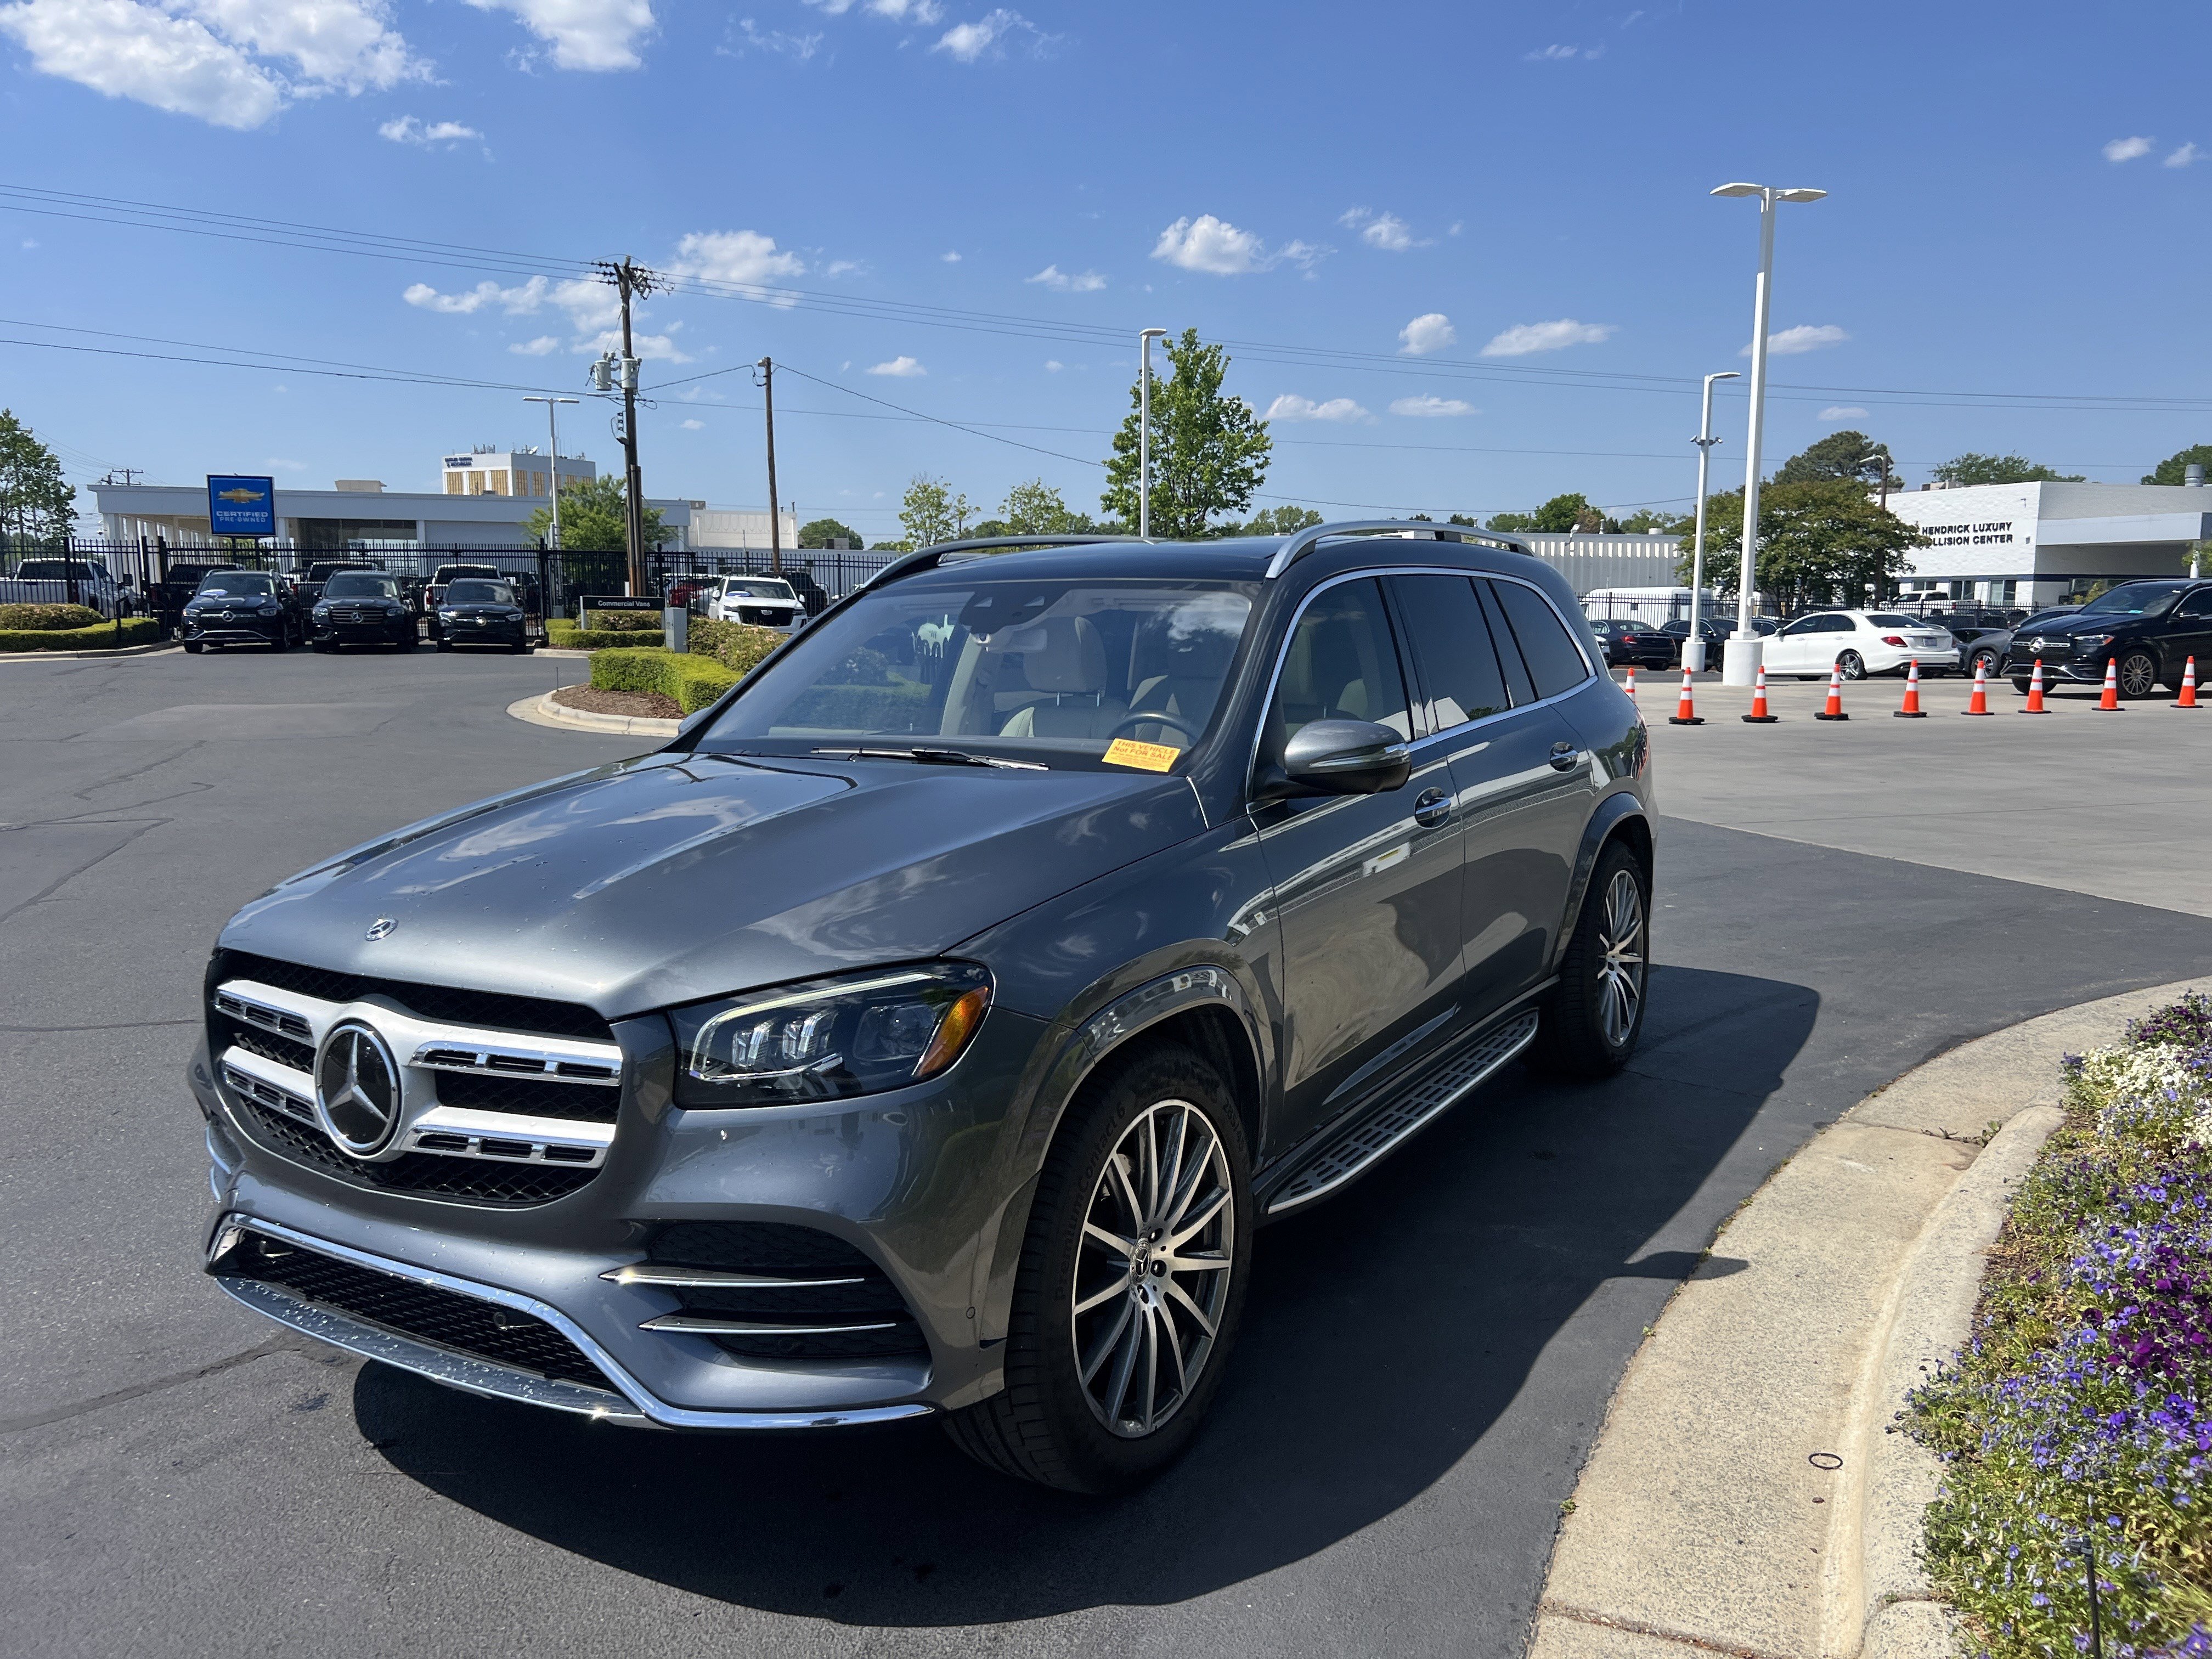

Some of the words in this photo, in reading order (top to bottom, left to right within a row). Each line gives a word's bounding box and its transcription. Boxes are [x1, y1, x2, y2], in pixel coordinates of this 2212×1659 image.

[1922, 524, 1970, 535] HENDRICK
[1973, 522, 2013, 533] LUXURY
[1930, 536, 1970, 546] LLISION
[1972, 534, 2013, 545] CENTER
[1139, 744, 1177, 755] VEHICLE
[1053, 1116, 1118, 1302] PremiumContact
[1116, 1101, 1126, 1120] 6
